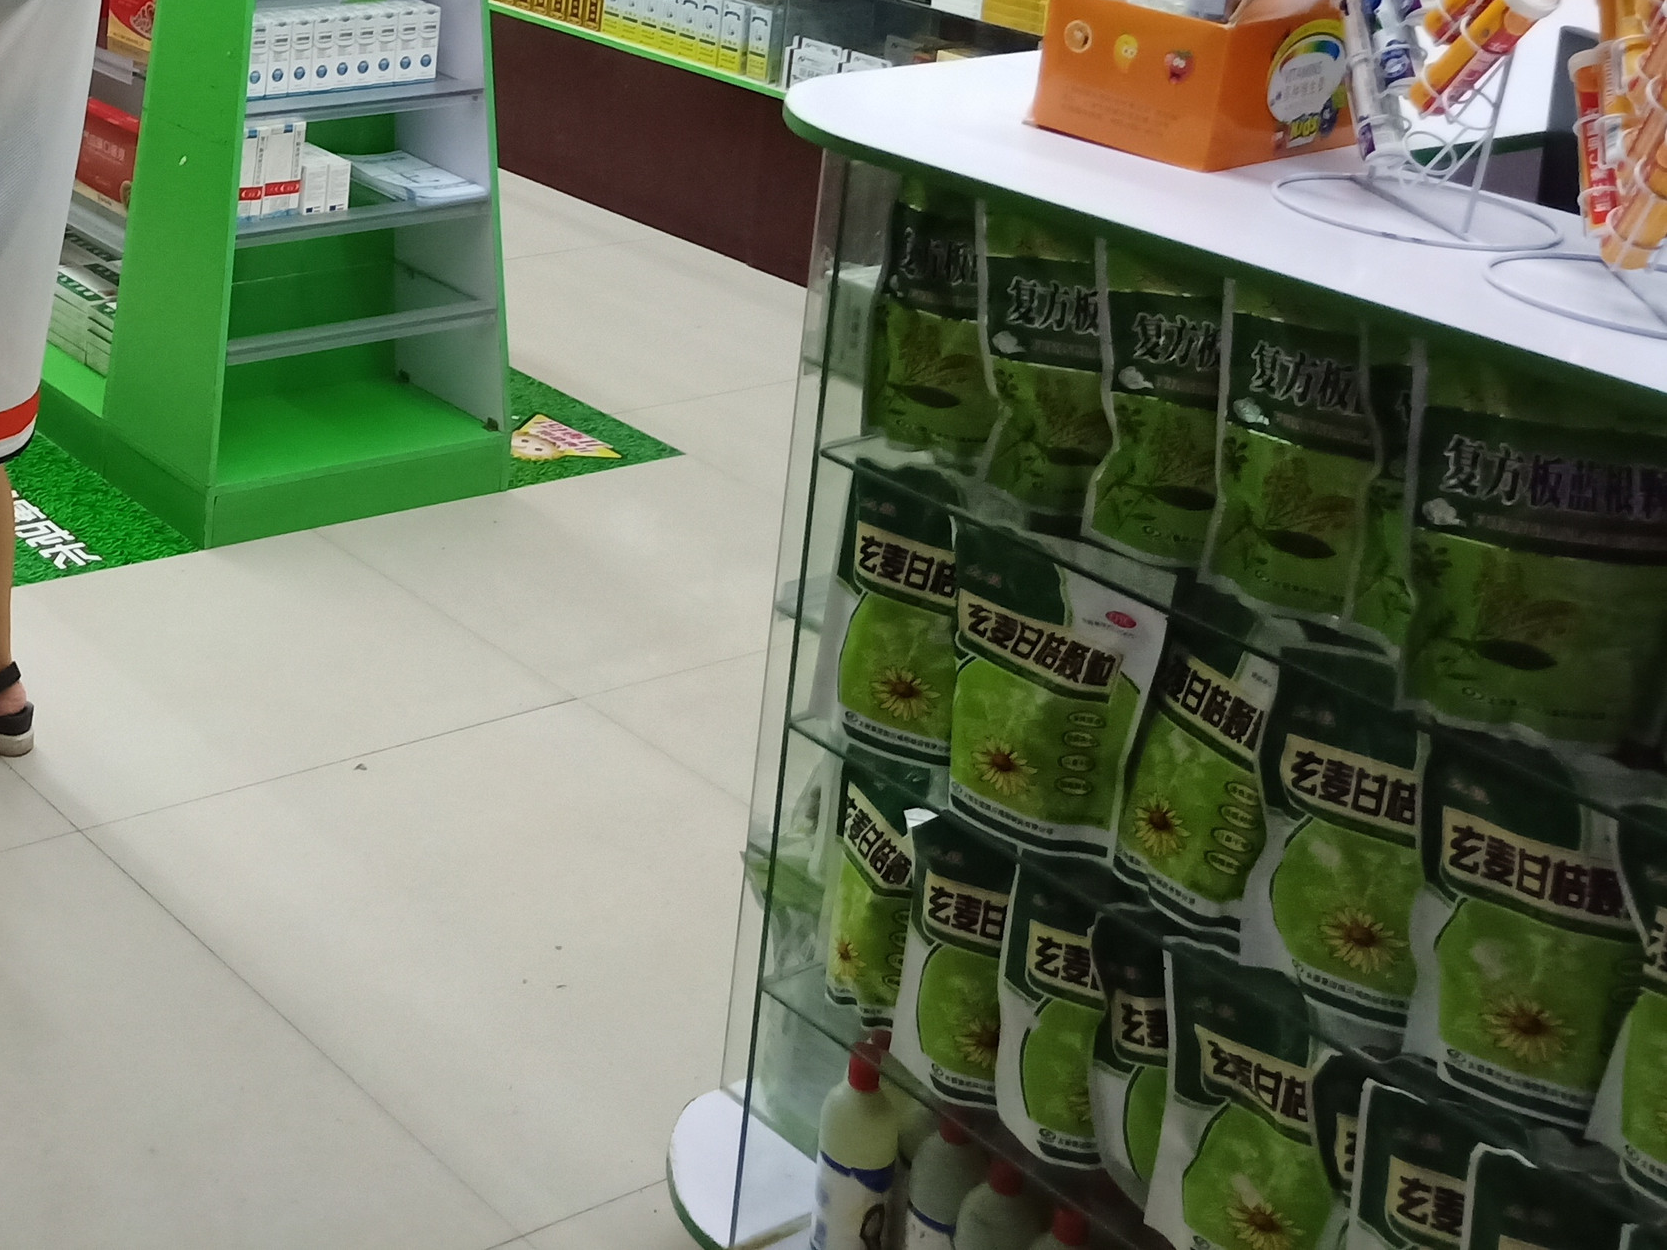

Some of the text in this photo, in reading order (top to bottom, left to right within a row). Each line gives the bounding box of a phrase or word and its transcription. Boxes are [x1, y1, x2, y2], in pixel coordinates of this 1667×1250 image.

[1249, 338, 1364, 416] 复方板
[967, 602, 1118, 688] 玄麦甘桔颗粒
[1033, 936, 1100, 990] 玄麦
